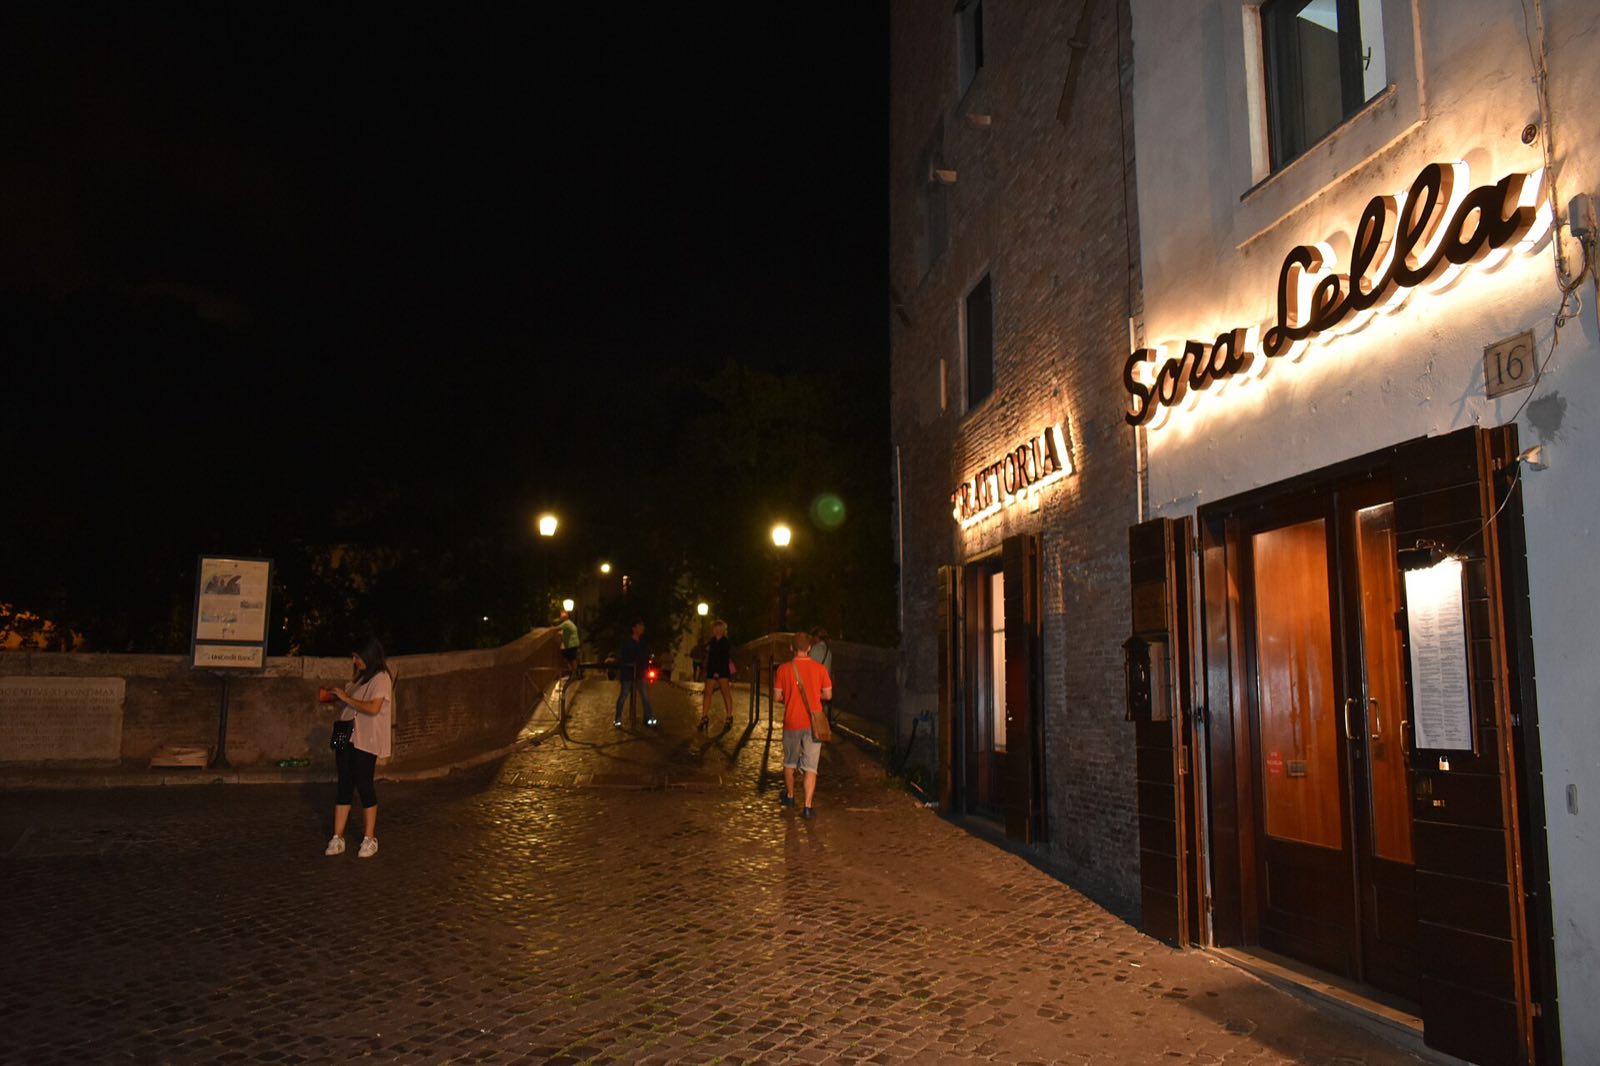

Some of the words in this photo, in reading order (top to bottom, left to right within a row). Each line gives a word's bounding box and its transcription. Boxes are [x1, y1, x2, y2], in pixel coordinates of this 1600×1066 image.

[1123, 327, 1253, 427] Sora
[1263, 162, 1536, 358] Lella
[1495, 349, 1525, 386] 16
[951, 426, 1062, 520] TRATTORIA
